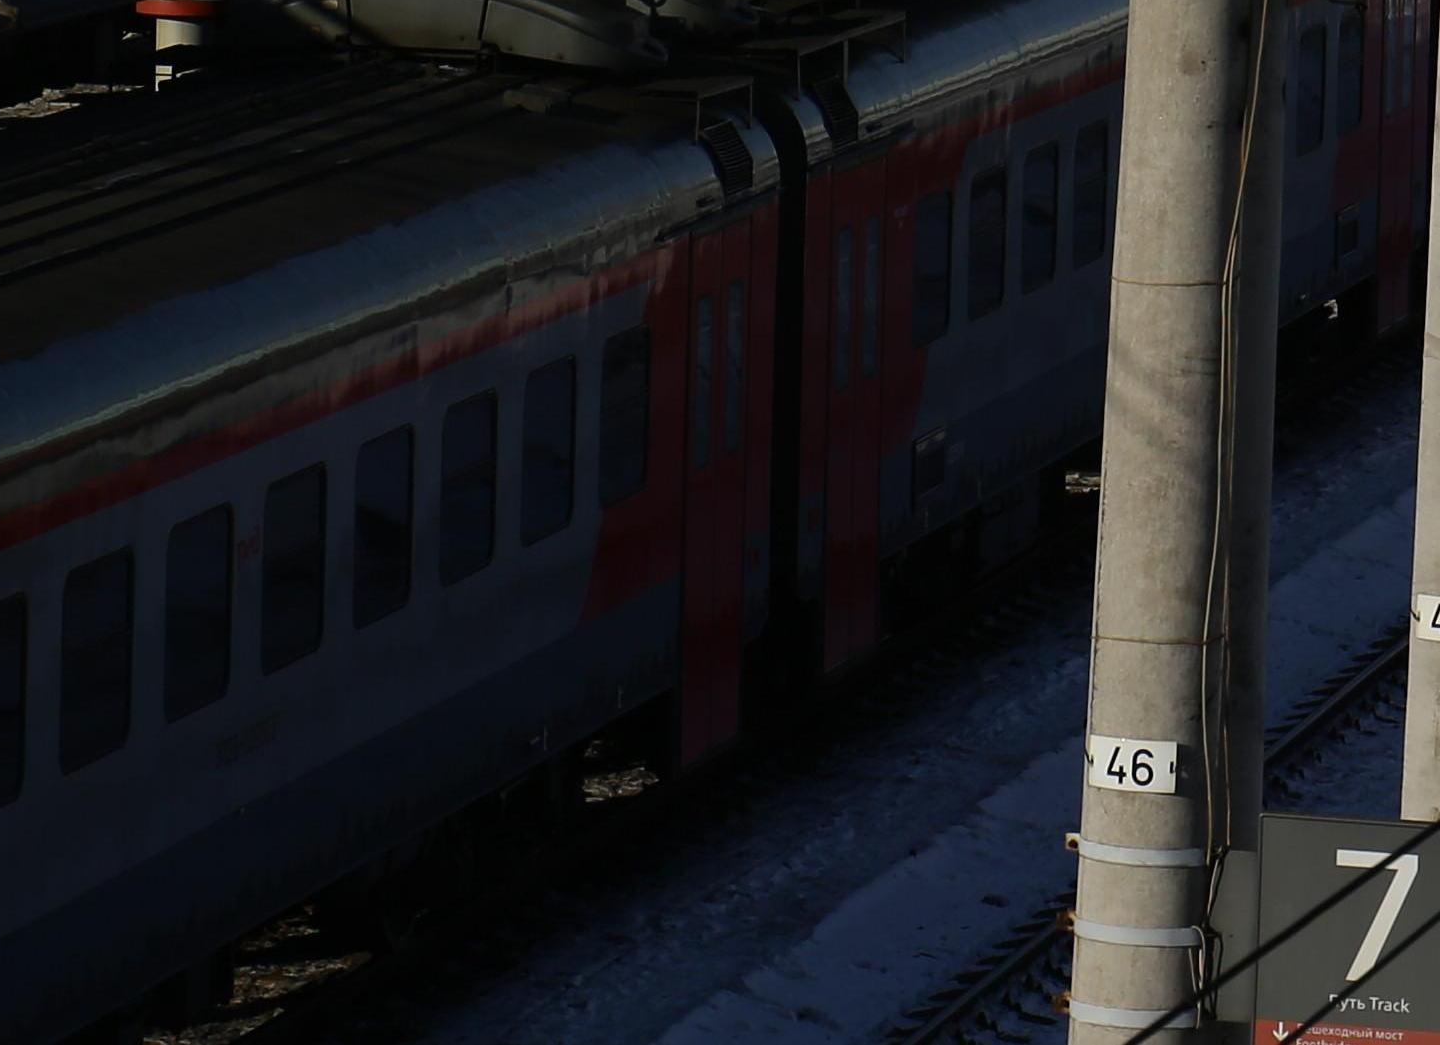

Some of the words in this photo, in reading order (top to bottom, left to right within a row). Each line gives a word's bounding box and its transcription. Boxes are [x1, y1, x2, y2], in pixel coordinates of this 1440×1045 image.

[1107, 746, 1154, 786] 46
[1335, 848, 1420, 983] 7
[1369, 996, 1410, 1013] Track
[1297, 1023, 1373, 1039] шеходный
[1375, 1031, 1404, 1041] мост
